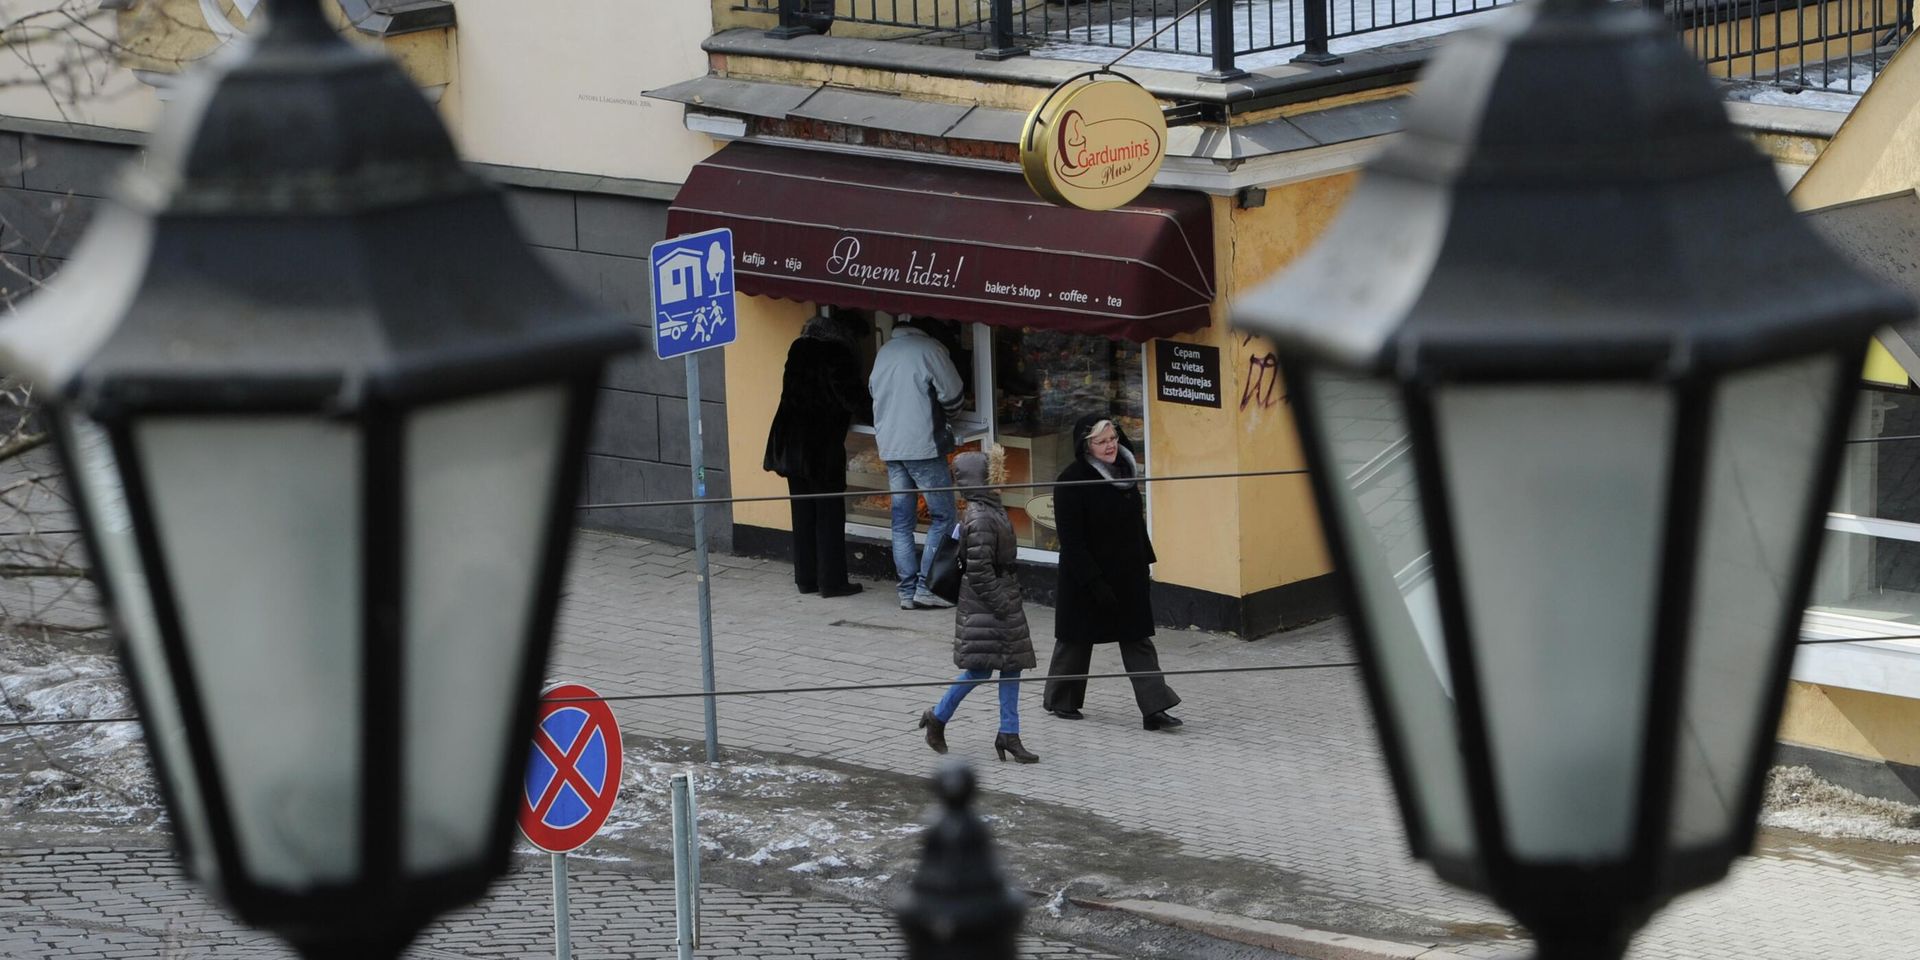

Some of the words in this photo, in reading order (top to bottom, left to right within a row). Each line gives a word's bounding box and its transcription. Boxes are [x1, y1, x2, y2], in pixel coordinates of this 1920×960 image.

[1077, 139, 1150, 168] Gardumiņš
[1101, 160, 1132, 185] Pluss
[742, 251, 765, 266] kafija
[785, 257, 802, 270] tēja
[826, 236, 900, 285] Paņem
[905, 250, 964, 289] līdzi!
[985, 280, 1017, 296] baker's
[1018, 285, 1041, 300] shop
[1059, 290, 1088, 303] coffee
[1107, 295, 1122, 307] tea
[1174, 346, 1201, 359] Cepam
[1171, 362, 1181, 370] uz
[1182, 362, 1204, 373] vietas
[1165, 372, 1212, 389] konditorejas
[1162, 385, 1215, 402] izstrādājumus
